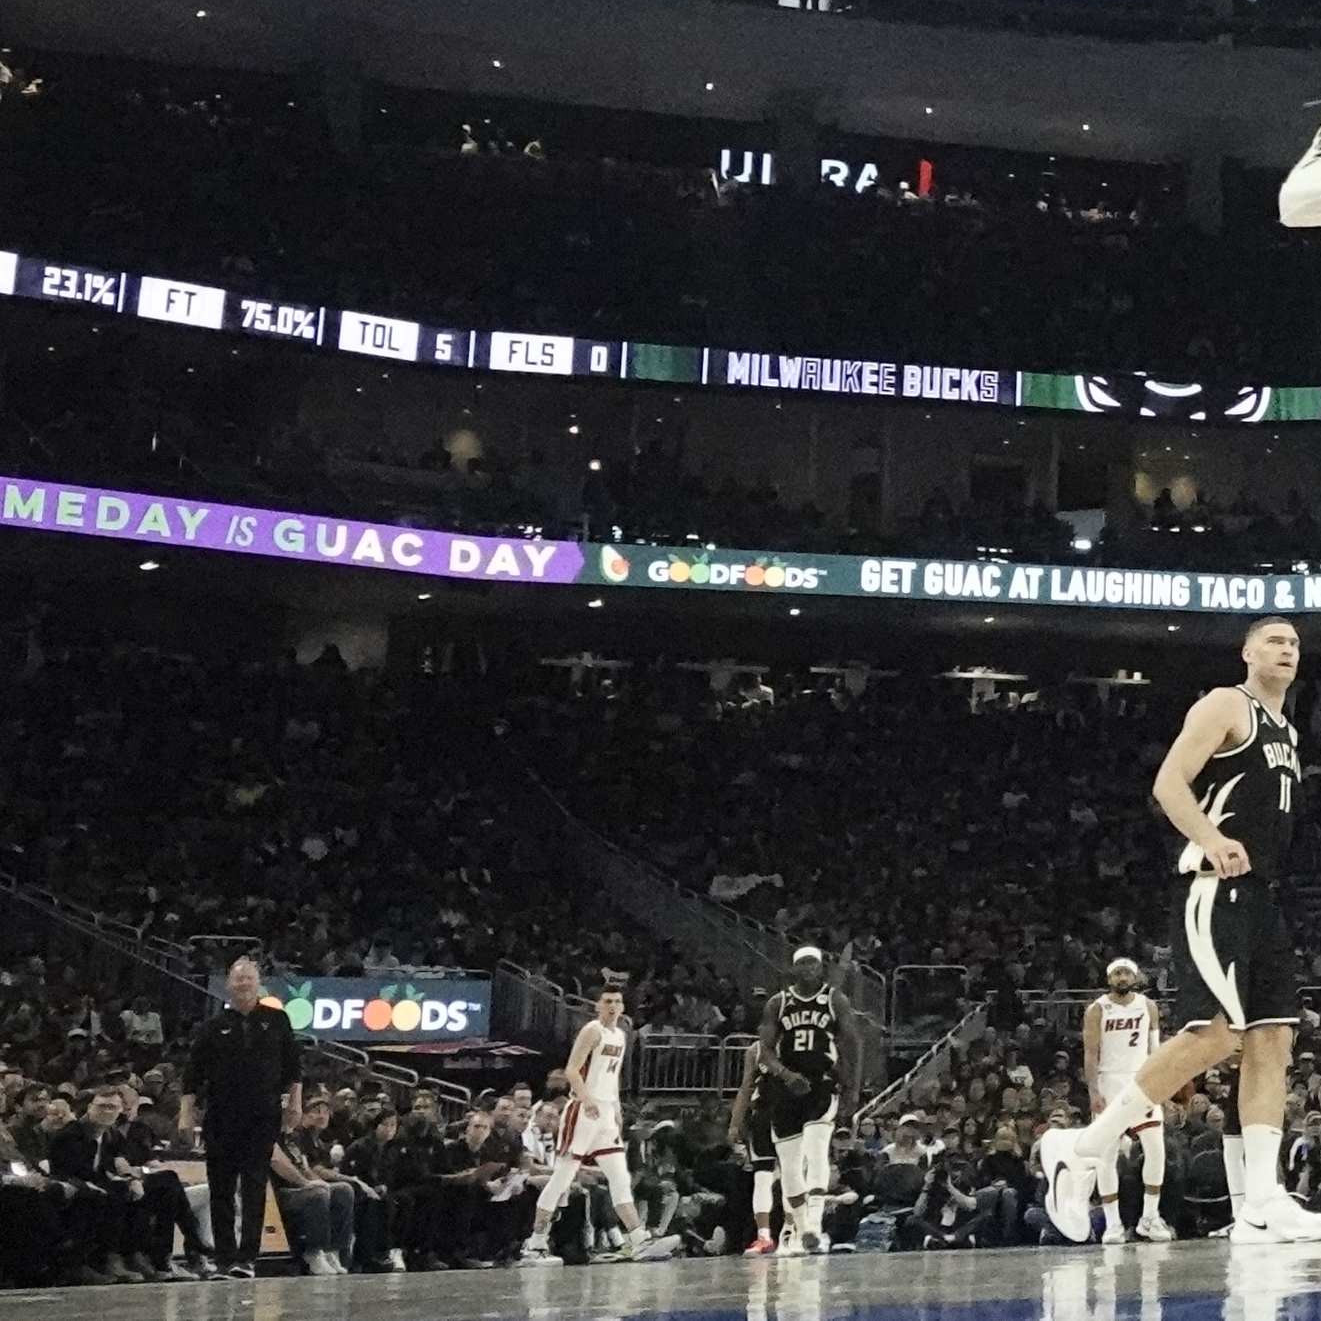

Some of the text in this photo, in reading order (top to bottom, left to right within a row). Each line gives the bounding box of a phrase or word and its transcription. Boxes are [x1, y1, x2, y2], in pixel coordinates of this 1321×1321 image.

[42, 266, 116, 306] 23.1%
[165, 288, 197, 317] FT
[240, 299, 315, 339] 75.0%
[358, 320, 401, 352] TOL
[434, 333, 453, 361] 5
[508, 340, 555, 367] FLS
[727, 351, 896, 396] MILWAUKEE
[902, 364, 999, 403] BUCKS
[225, 516, 258, 547] IS
[273, 519, 424, 567] GUAC
[449, 539, 557, 578] DAY
[861, 559, 917, 594] GET
[924, 562, 1001, 599] GUAC
[1009, 567, 1043, 600] AT
[1051, 568, 1191, 607] LAUGHING
[1198, 576, 1265, 610] TACO
[1274, 580, 1295, 609] &
[1279, 773, 1292, 813] 11
[781, 1011, 832, 1030] BUCKS
[1105, 1013, 1145, 1032] HEAT
[794, 1030, 815, 1051] 21
[1129, 1031, 1139, 1047] 2
